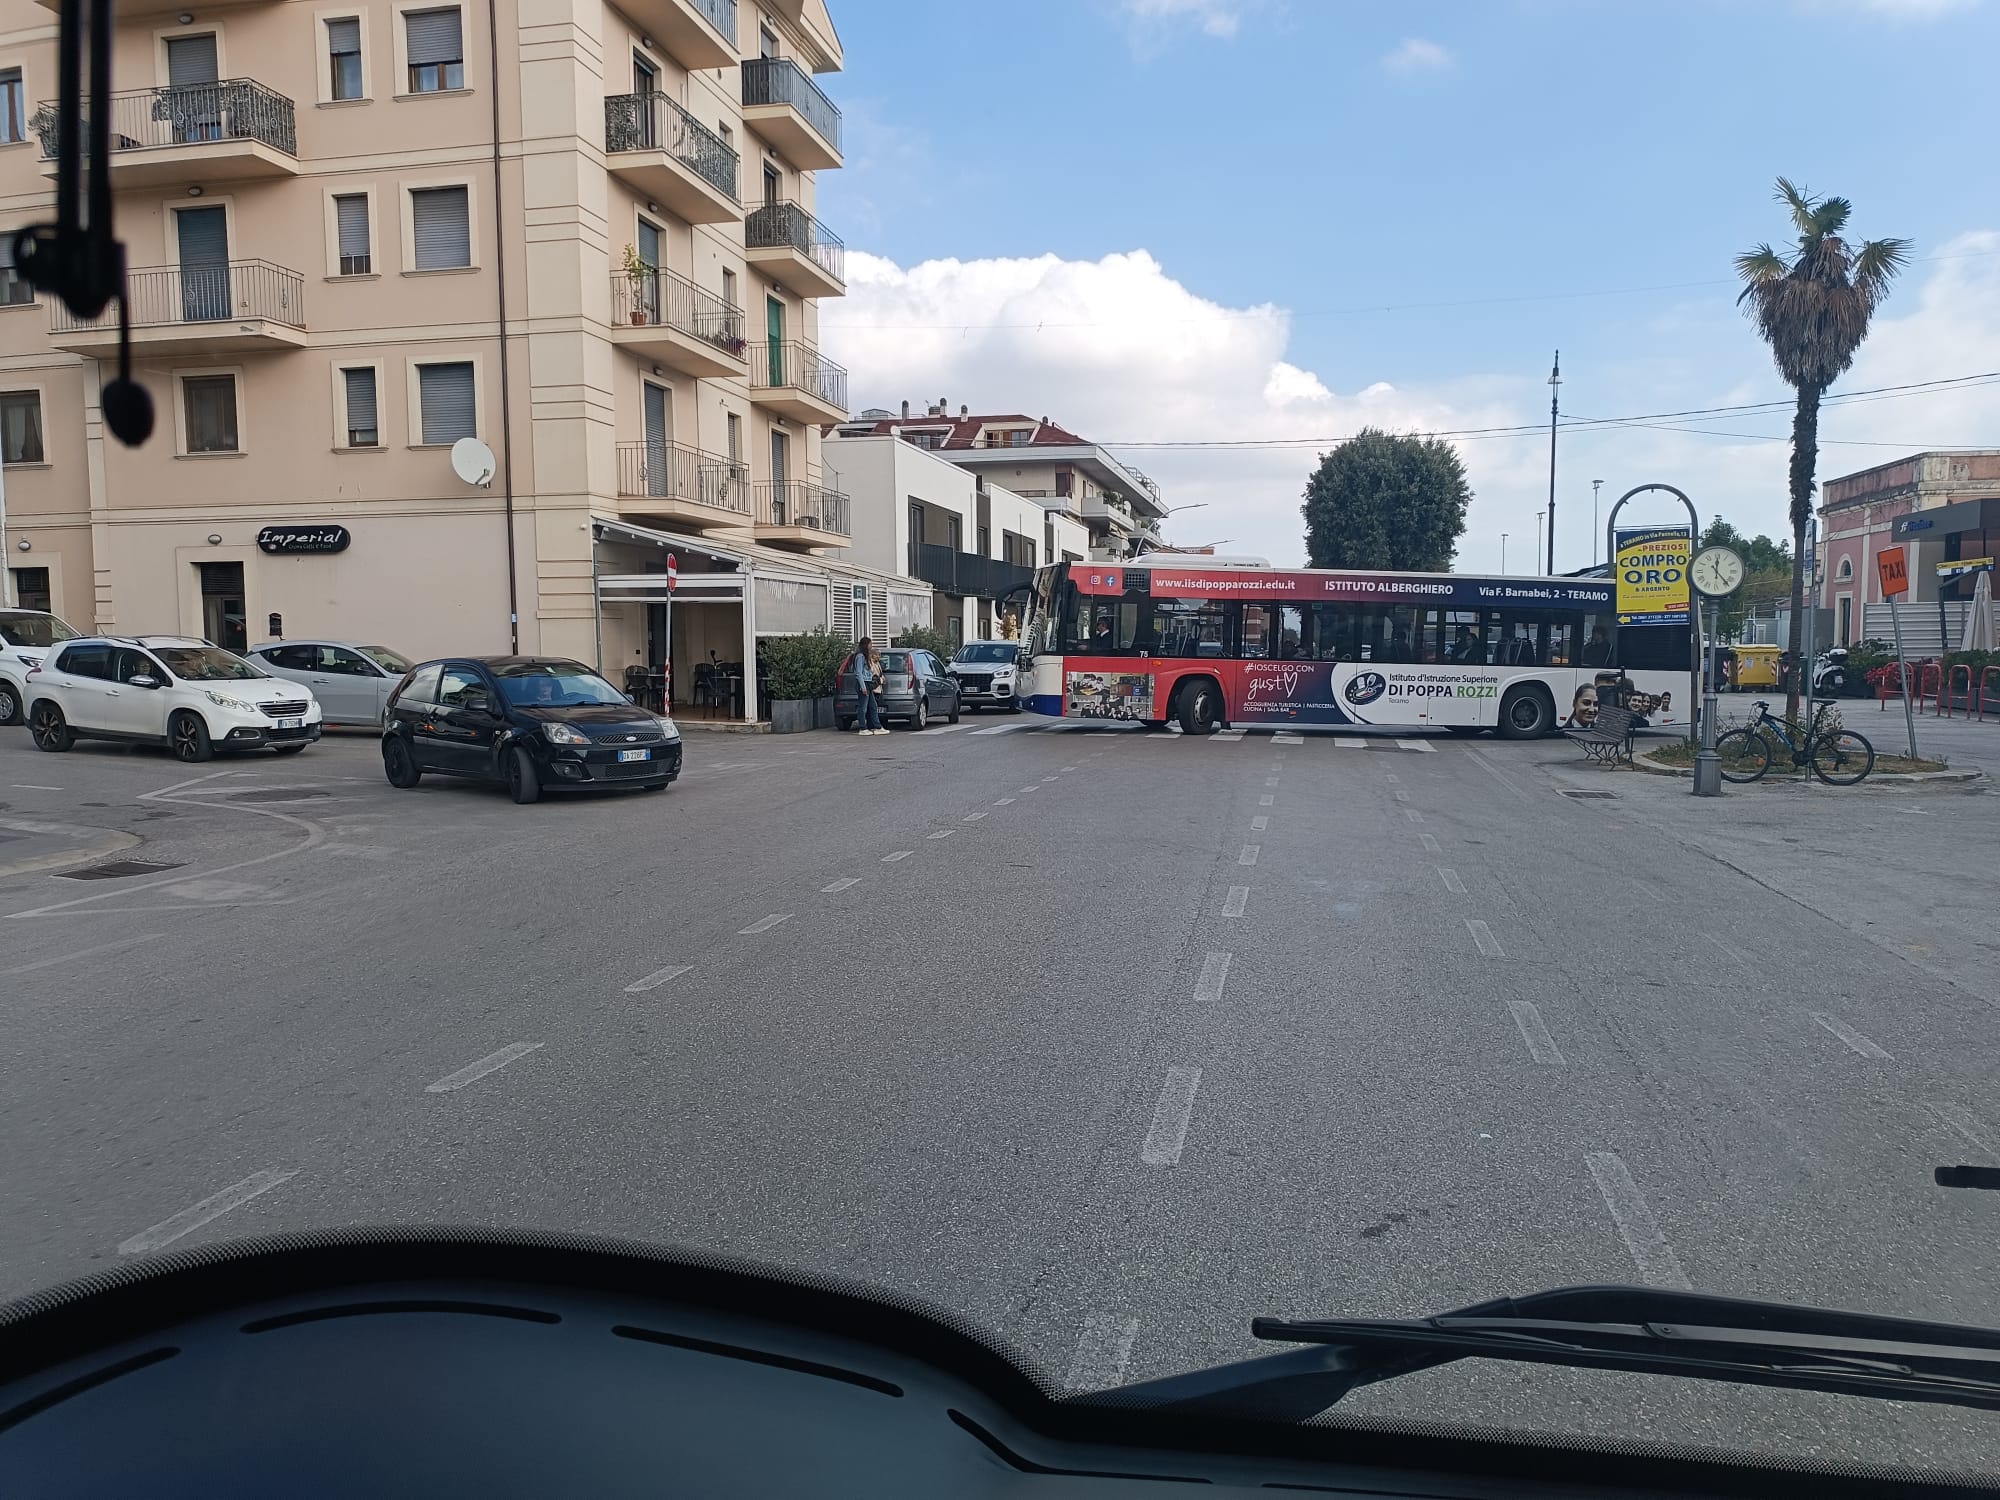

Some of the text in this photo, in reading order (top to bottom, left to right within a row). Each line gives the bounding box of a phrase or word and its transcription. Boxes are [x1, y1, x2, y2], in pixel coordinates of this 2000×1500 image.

[260, 530, 342, 546] Imperial
[1642, 544, 1687, 552] PREZIOSI
[1620, 554, 1687, 568] COMPRO
[1624, 568, 1682, 584] ORO
[1882, 560, 1906, 581] TAXI
[1156, 578, 1296, 591] www.iisdipopparozzi.edu.it
[1324, 580, 1454, 594] ISTITUTO ALBERGHIERO
[1479, 586, 1494, 596] Via
[1496, 588, 1504, 596] F.
[1506, 587, 1552, 599] Barnabei,
[1554, 590, 1560, 598] 2
[1568, 590, 1608, 600] TERAMO
[1244, 662, 1294, 674] #IOSCELGO
[1390, 673, 1498, 685] Istituto d'Istruzione Superiore
[1388, 685, 1498, 698] DI POPPA ROZZI
